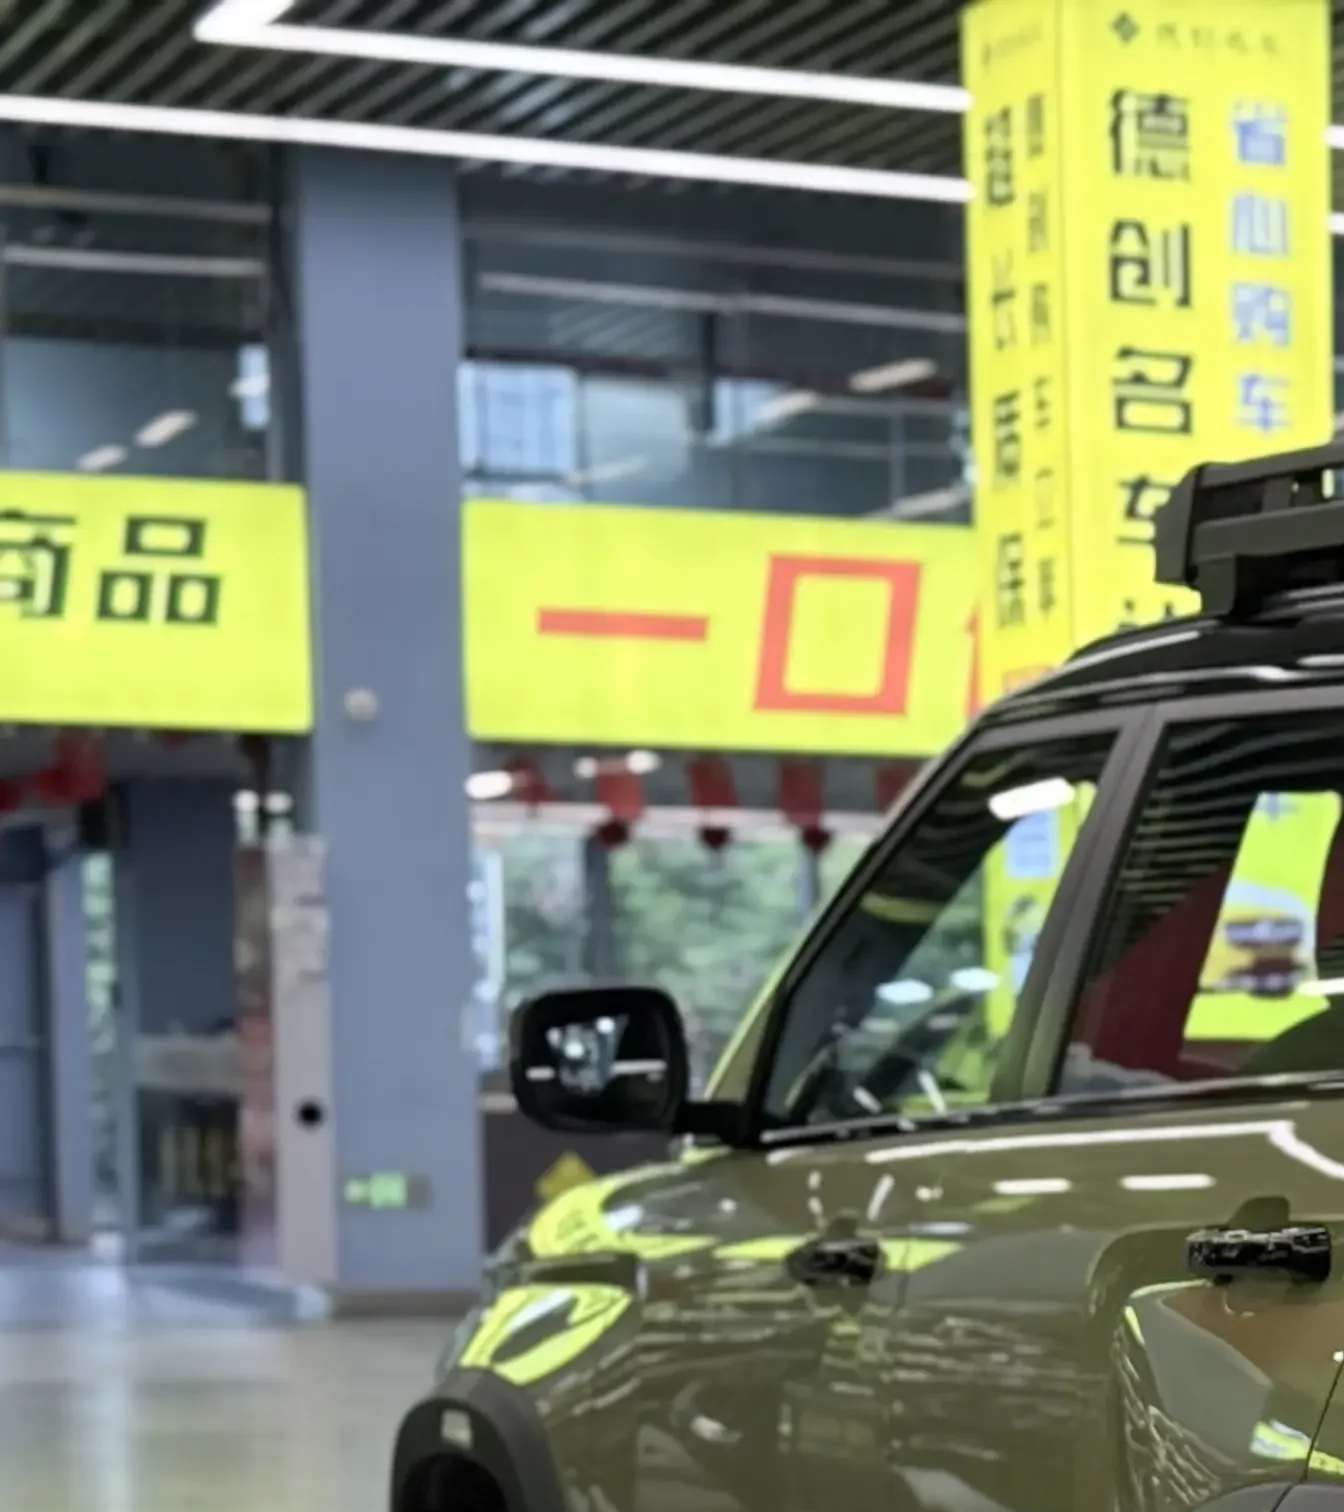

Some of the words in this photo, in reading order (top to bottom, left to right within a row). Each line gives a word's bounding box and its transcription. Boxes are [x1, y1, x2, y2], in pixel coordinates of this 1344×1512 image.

[1107, 87, 1193, 632] 德创名车
[1229, 100, 1292, 433] 省心购车
[537, 551, 980, 718] 一口
